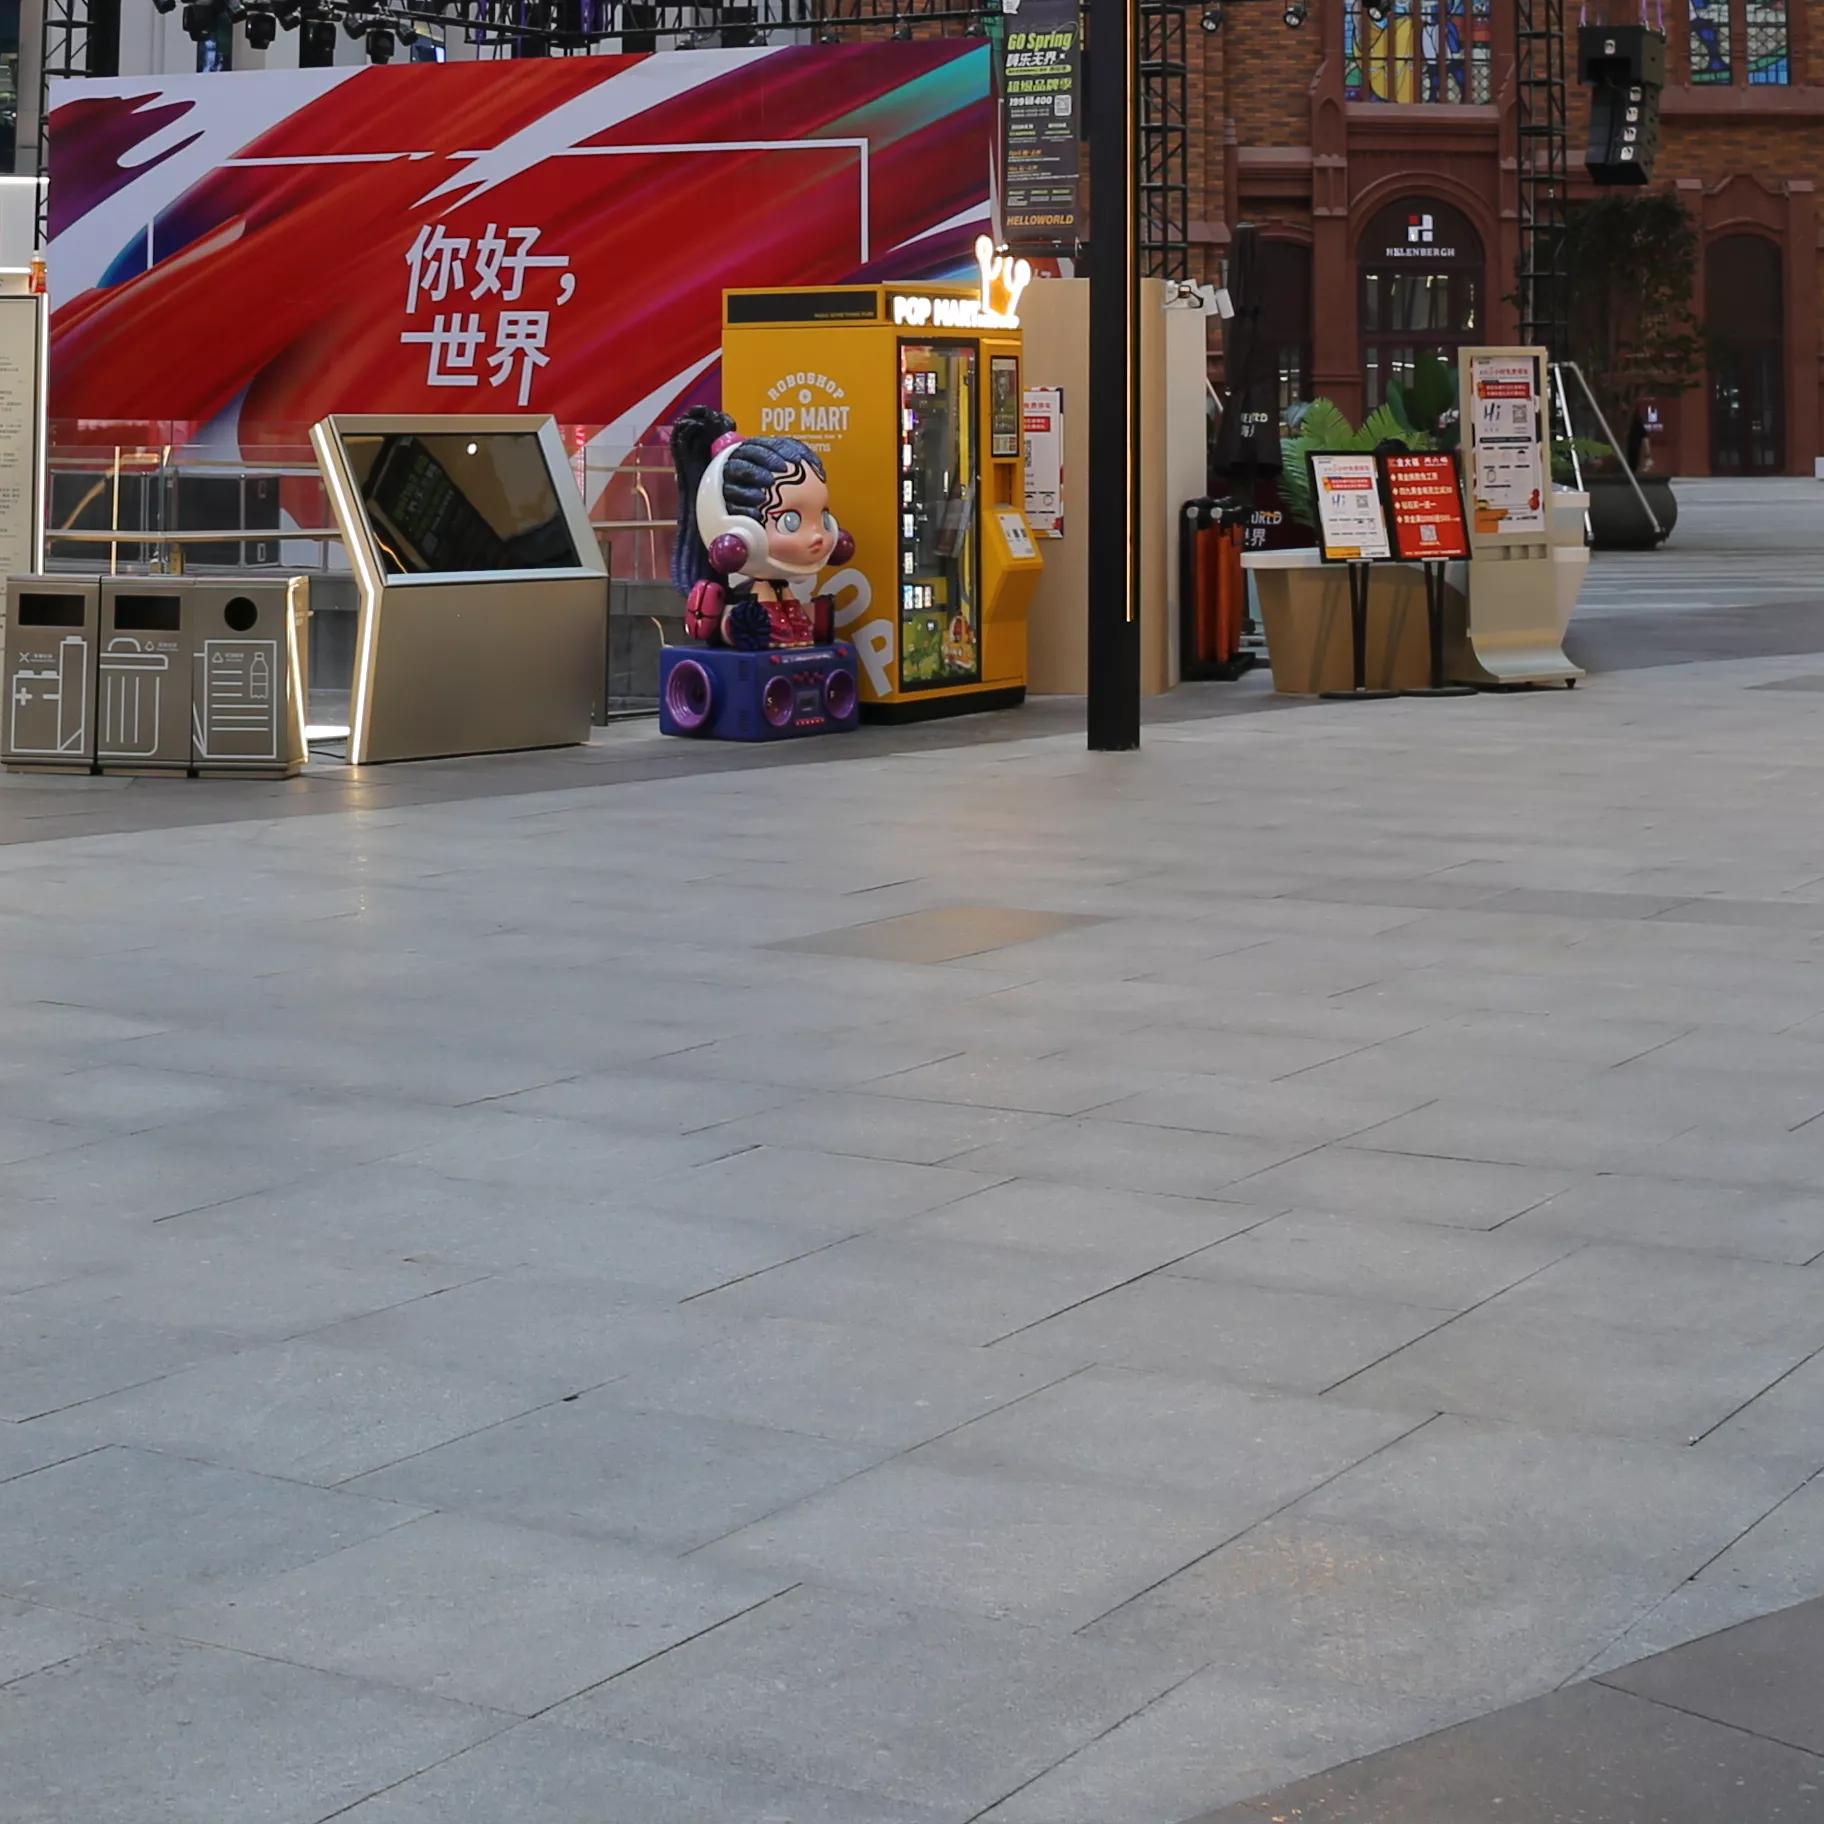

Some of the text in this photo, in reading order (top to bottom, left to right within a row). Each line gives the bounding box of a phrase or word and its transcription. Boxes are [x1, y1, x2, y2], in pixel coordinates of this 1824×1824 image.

[1007, 31, 1073, 52] GO Spring
[1006, 215, 1074, 227] HELLOWORLD
[893, 296, 932, 326] POP
[400, 309, 551, 406] 世界
[767, 371, 845, 401] ROBOSHOP
[761, 406, 851, 432] POP MART
